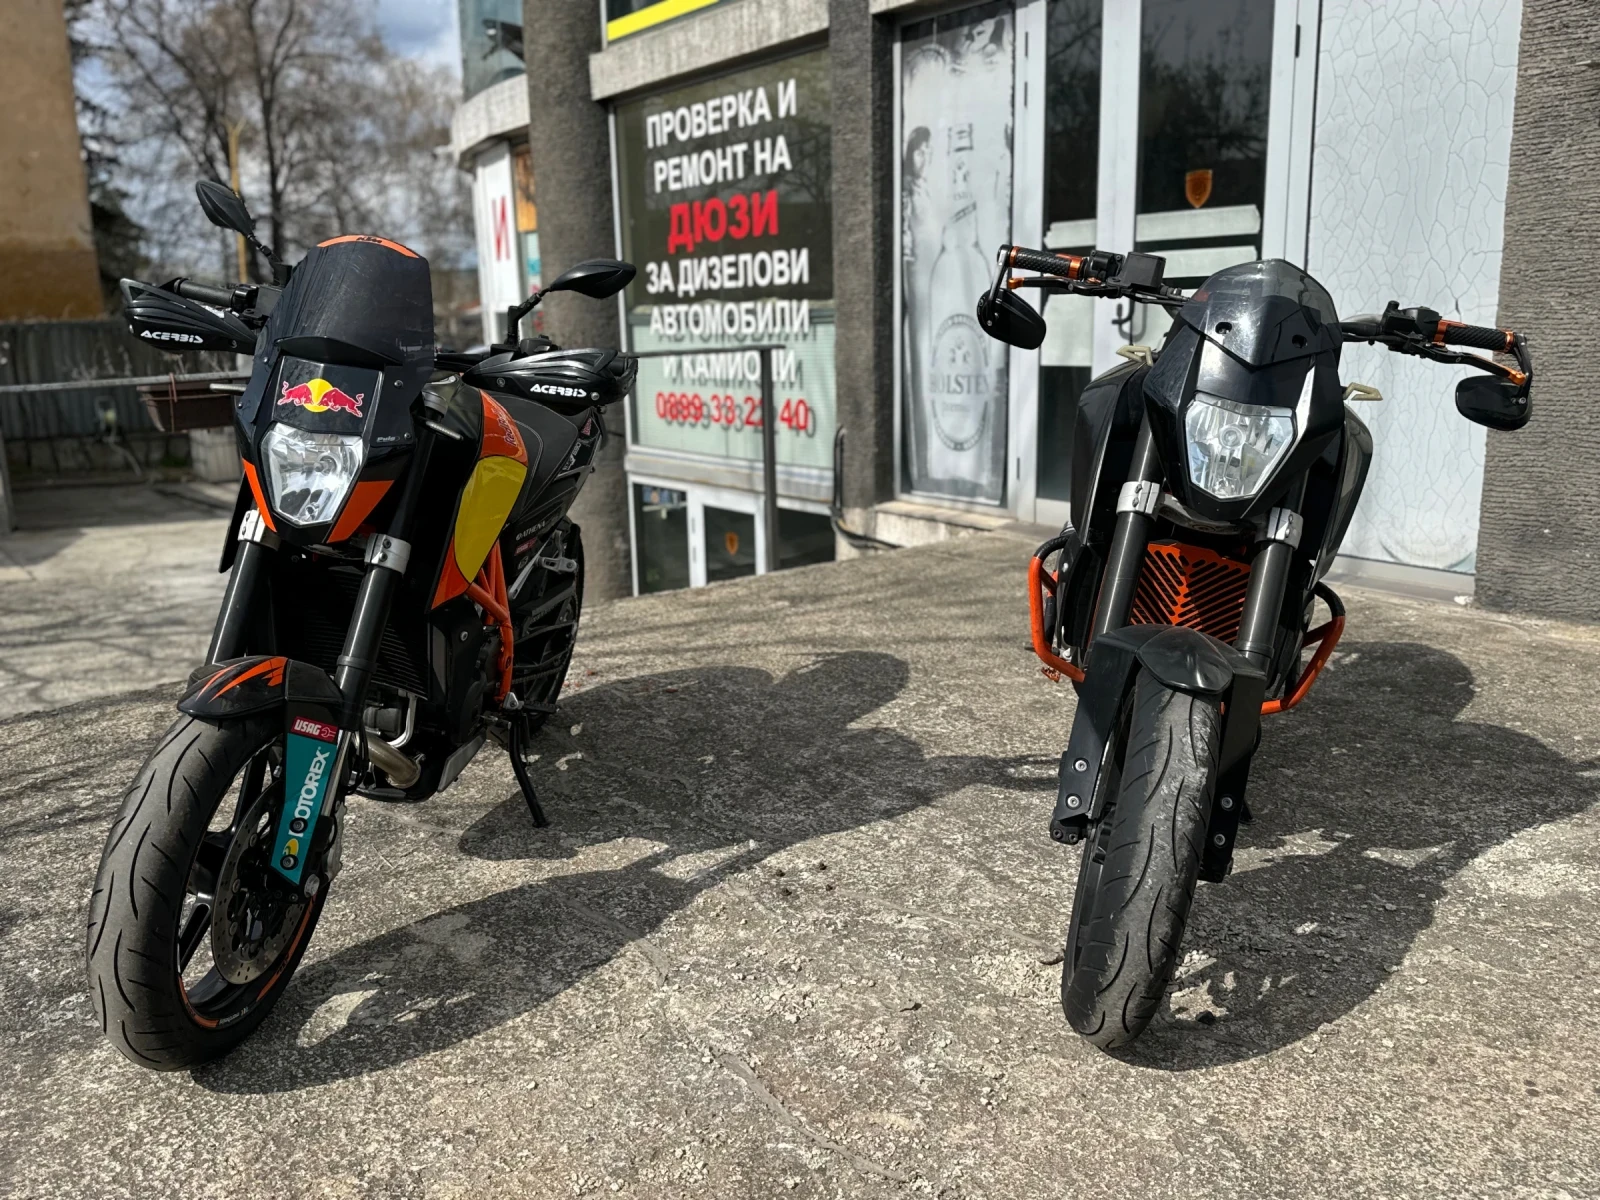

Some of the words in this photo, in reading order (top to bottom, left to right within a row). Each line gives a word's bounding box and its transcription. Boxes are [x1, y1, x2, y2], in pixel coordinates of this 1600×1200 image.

[646, 86, 773, 149] ПРОВЕРКА
[777, 77, 797, 119] И
[653, 142, 749, 194] РЕМОНТ
[753, 134, 793, 176] НА
[667, 189, 779, 255] ДЮЗИ
[645, 260, 675, 294] ЗА
[677, 247, 810, 298] ДИЗЕЛОВИ
[140, 329, 204, 344] ACERBIS
[650, 298, 811, 336] АВТОМОБИЛИ
[662, 355, 678, 379] И
[529, 383, 588, 398] ACERBIS
[655, 391, 703, 422] 0899
[711, 393, 736, 425] 33
[779, 397, 809, 430] 40
[294, 719, 322, 736] USAG
[288, 749, 331, 838] OTOREX
